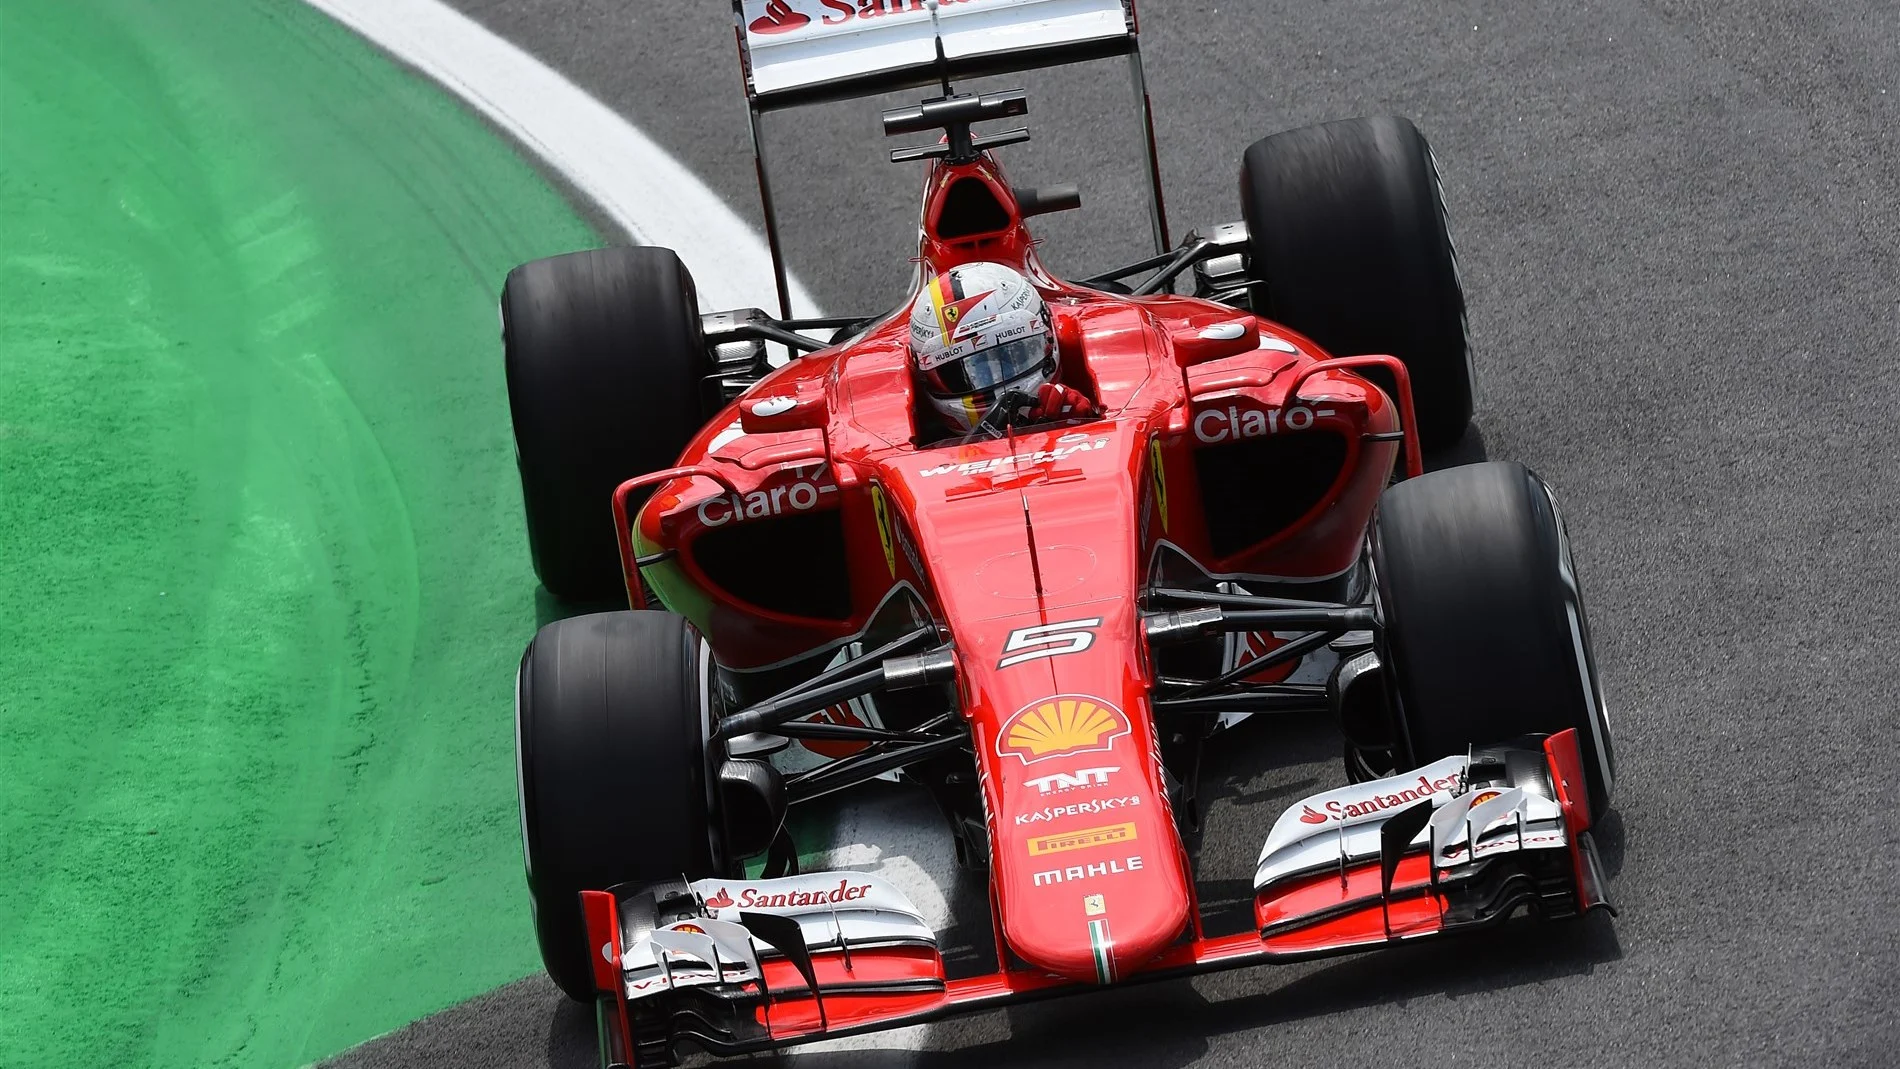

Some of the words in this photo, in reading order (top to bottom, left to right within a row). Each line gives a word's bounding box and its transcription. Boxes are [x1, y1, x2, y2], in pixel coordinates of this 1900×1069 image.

[995, 326, 1025, 339] HUBLOT
[935, 346, 963, 361] HUBLOT
[1194, 405, 1314, 443] Claro
[698, 481, 817, 527] Claro
[996, 617, 1103, 671] 5
[1022, 766, 1121, 793] TNT
[1040, 787, 1076, 798] ENERGY
[1080, 782, 1109, 791] DRINK
[1014, 796, 1129, 825] KASPERSKY
[1325, 772, 1462, 821] Santander
[1037, 826, 1127, 852] PIRELLI
[1033, 855, 1144, 887] MAHLE
[737, 879, 872, 909] Santander
